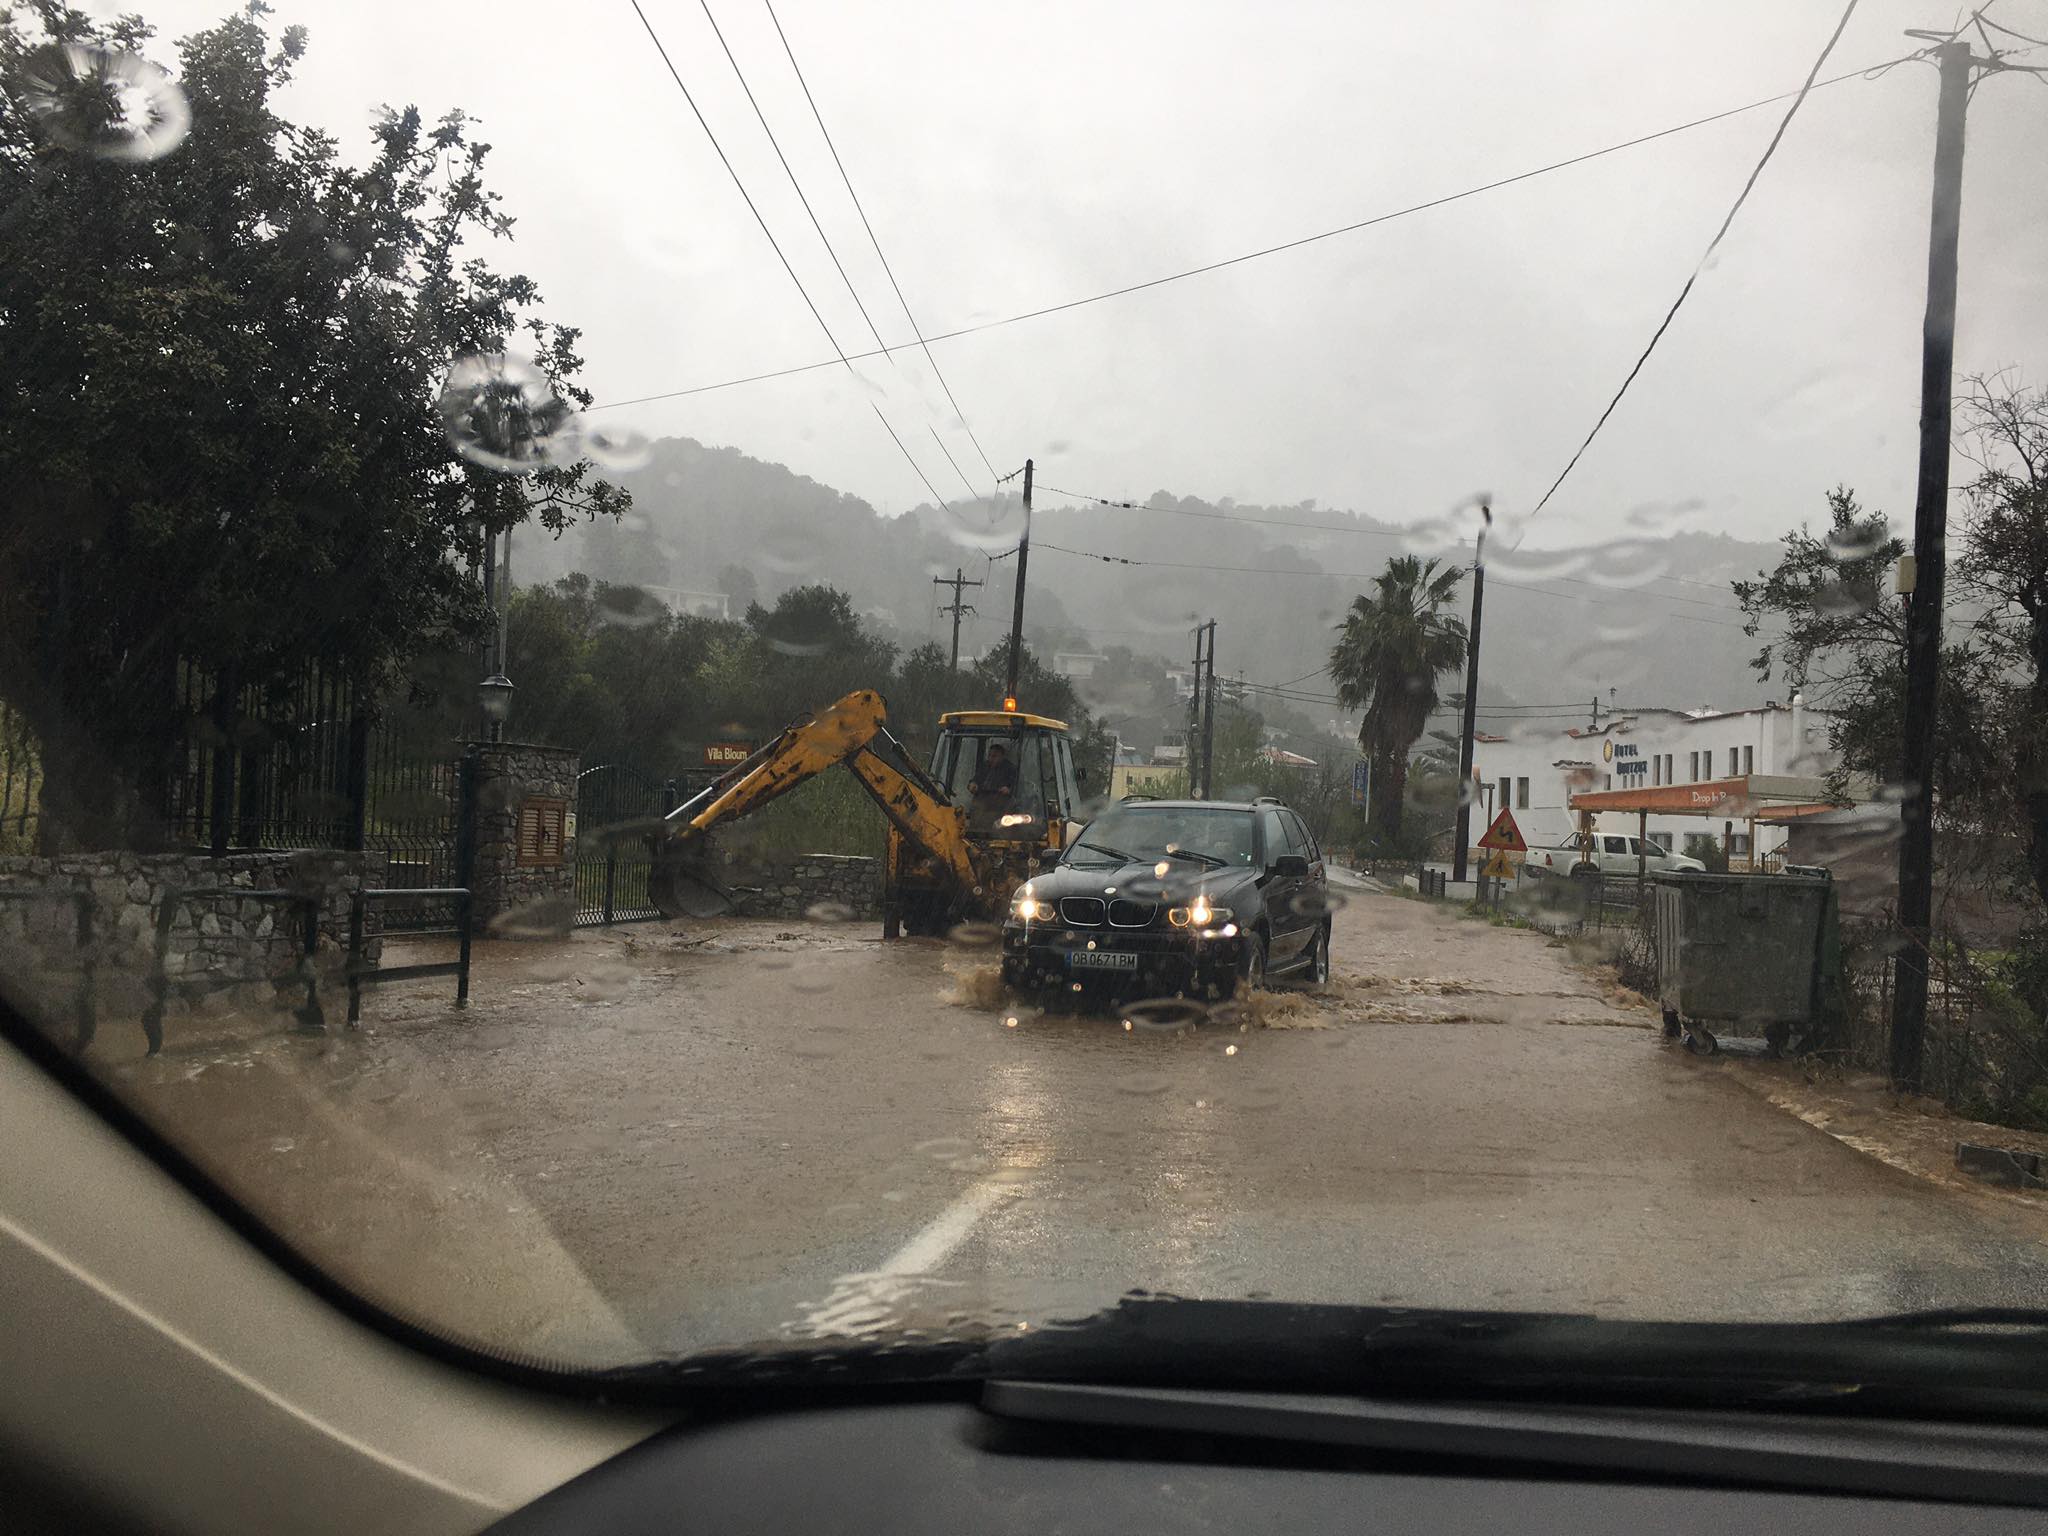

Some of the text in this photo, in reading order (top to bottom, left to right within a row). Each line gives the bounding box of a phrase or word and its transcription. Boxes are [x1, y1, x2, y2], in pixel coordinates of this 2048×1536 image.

[707, 748, 722, 760] Villa
[1693, 792, 1711, 804] Drop
[1090, 954, 1116, 966] 0671
[1120, 955, 1135, 968] BM
